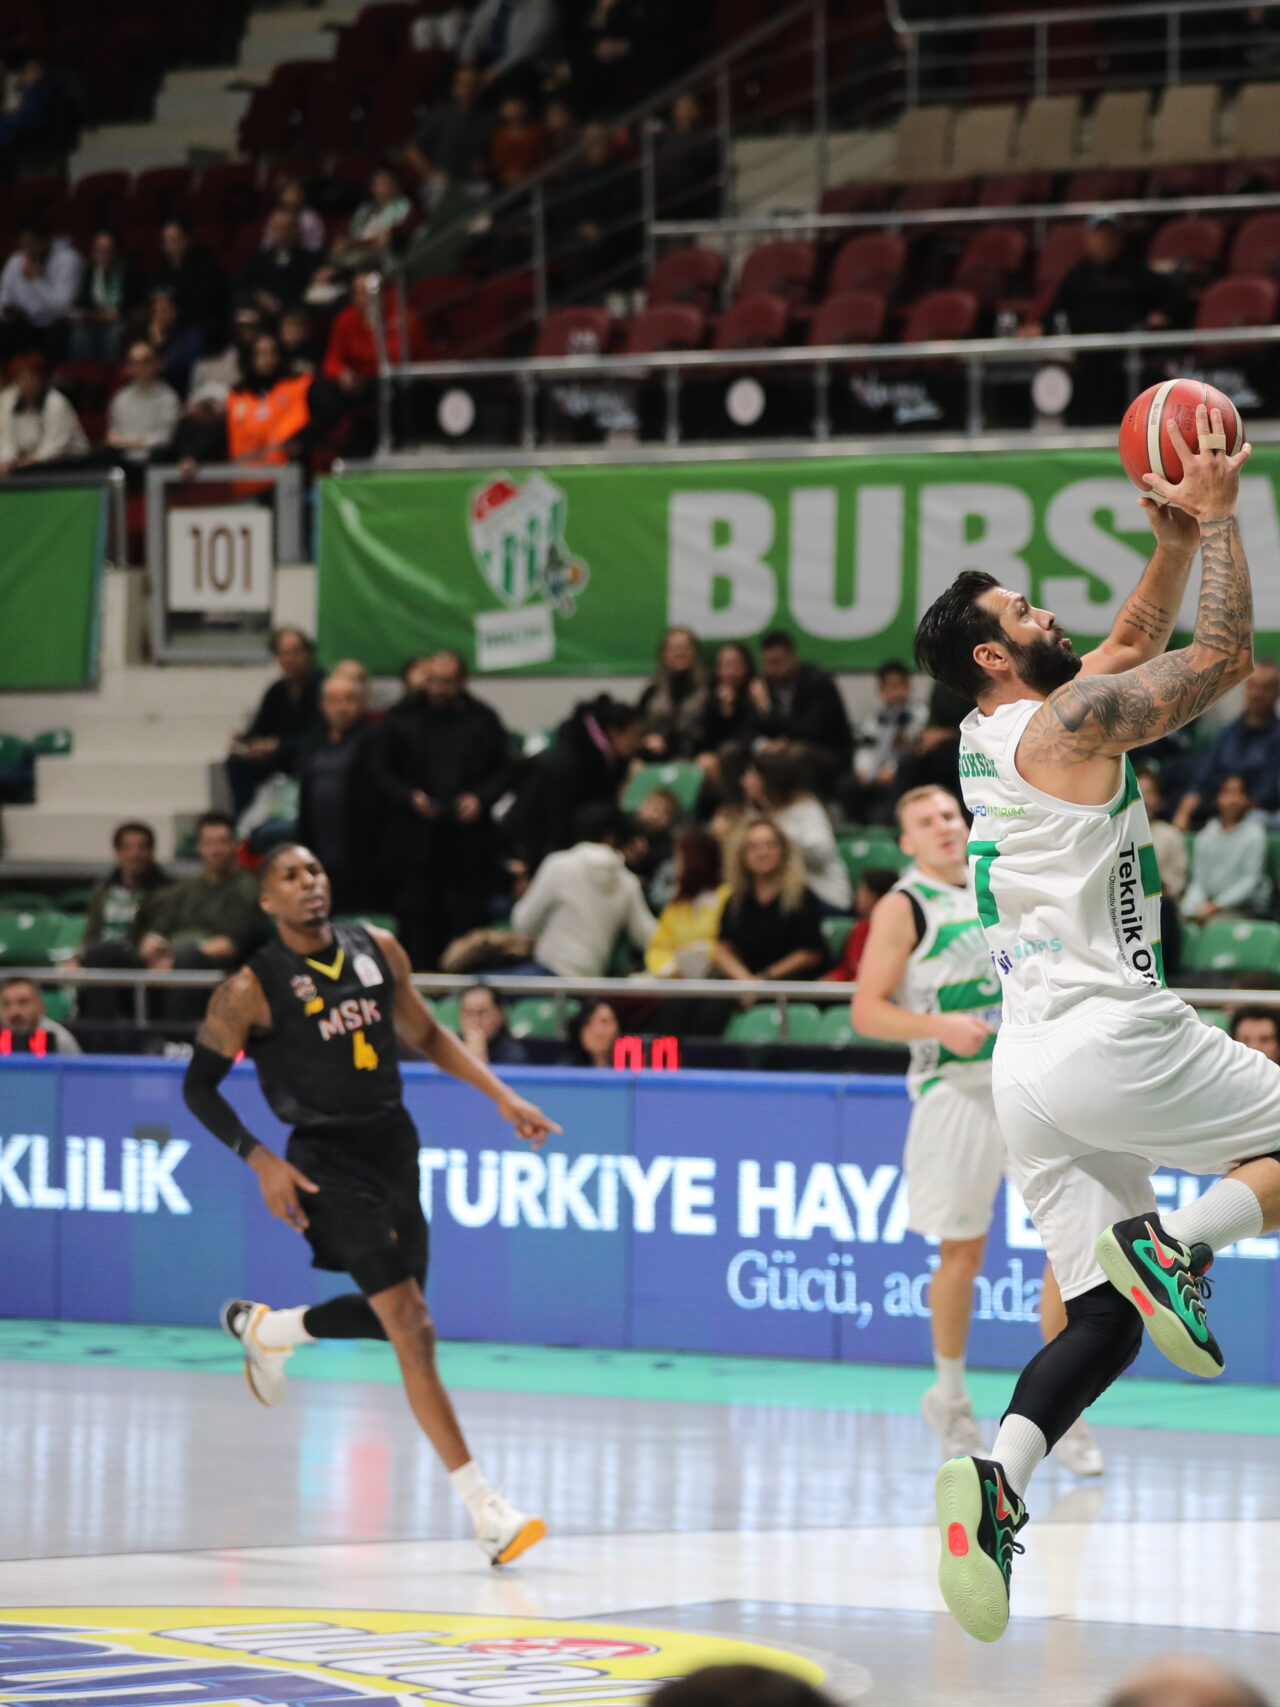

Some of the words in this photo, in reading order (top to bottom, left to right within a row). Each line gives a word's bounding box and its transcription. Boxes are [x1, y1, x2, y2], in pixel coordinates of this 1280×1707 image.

[188, 524, 253, 595] 101
[1119, 842, 1143, 944] Teknik
[318, 998, 382, 1041] MSK
[417, 1147, 717, 1235] TÜRKİYE
[726, 1249, 873, 1329] Gücü,
